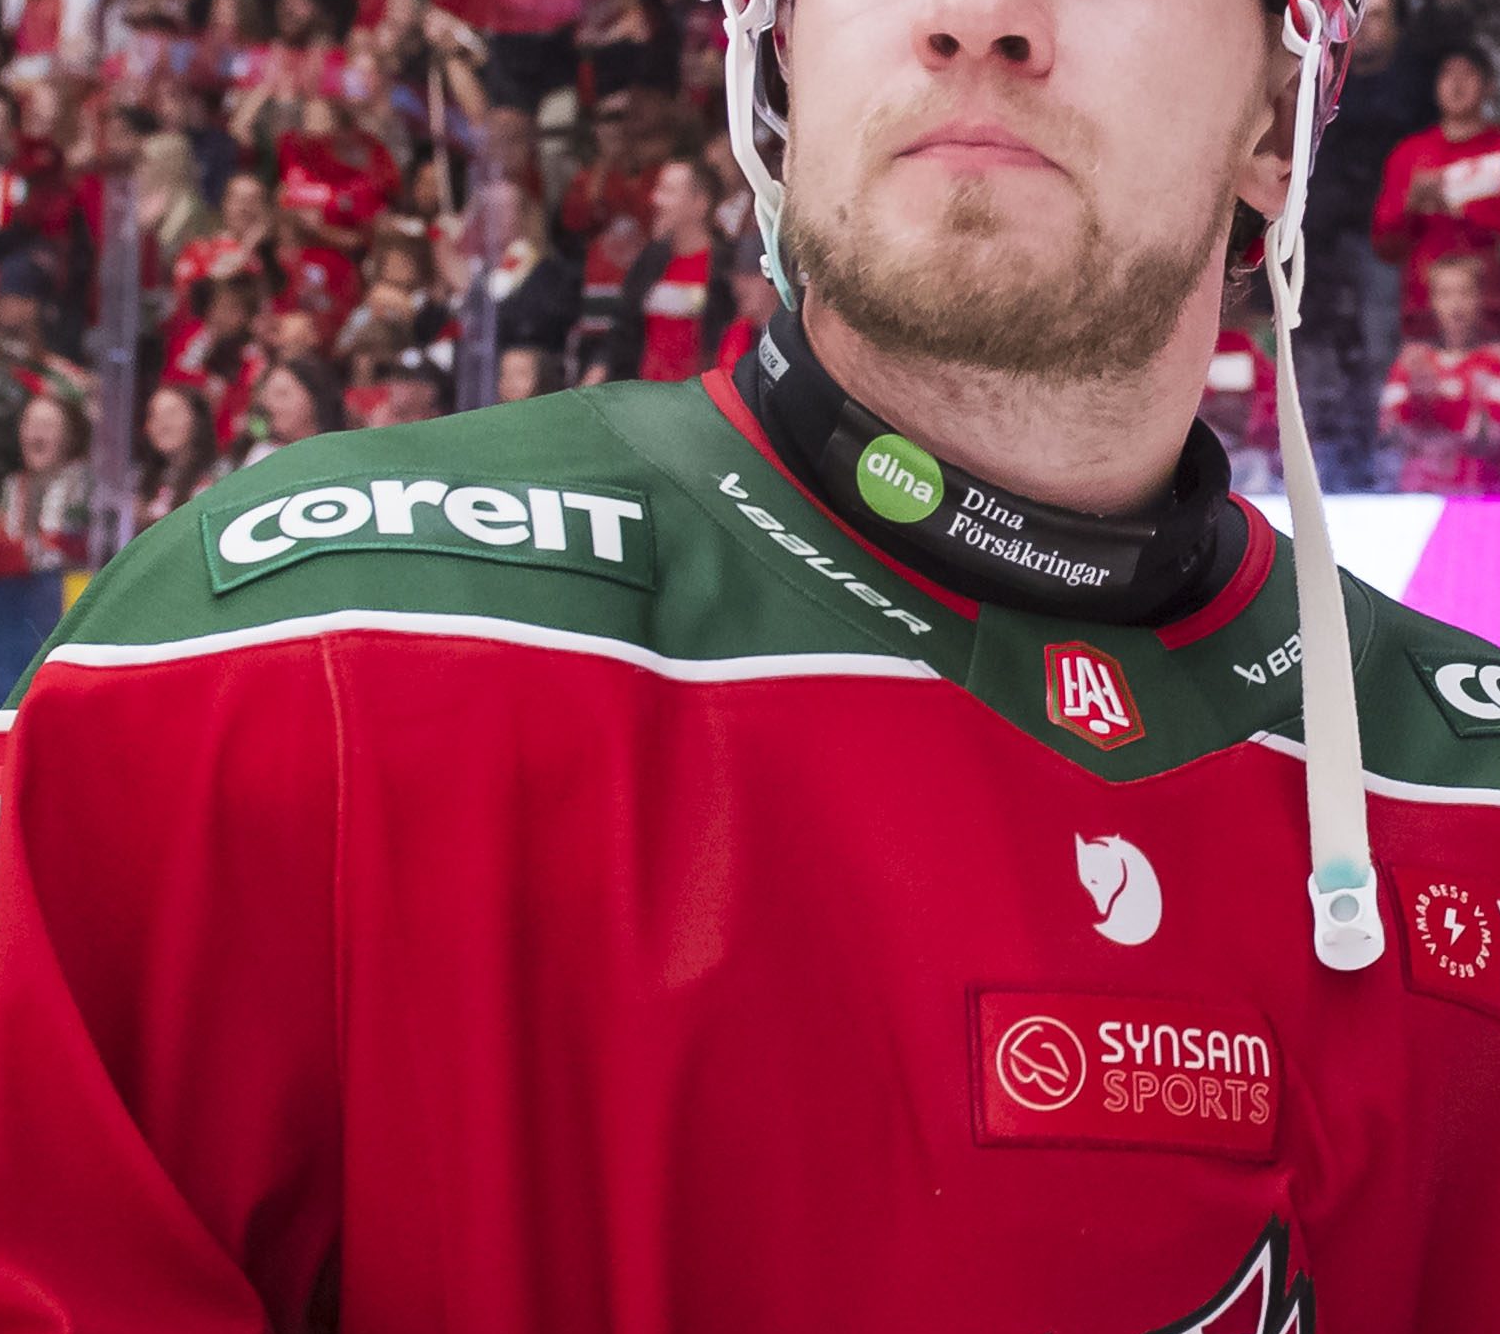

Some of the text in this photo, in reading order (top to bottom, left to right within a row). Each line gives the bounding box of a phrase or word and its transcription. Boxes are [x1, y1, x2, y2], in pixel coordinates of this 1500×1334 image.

[866, 452, 935, 504] dina
[962, 487, 1025, 532] Dina
[946, 511, 1111, 588] Försäkringar
[1428, 883, 1469, 904] BESS
[1097, 1020, 1271, 1079] SYNSAM
[1102, 1068, 1271, 1126] SPORTS
